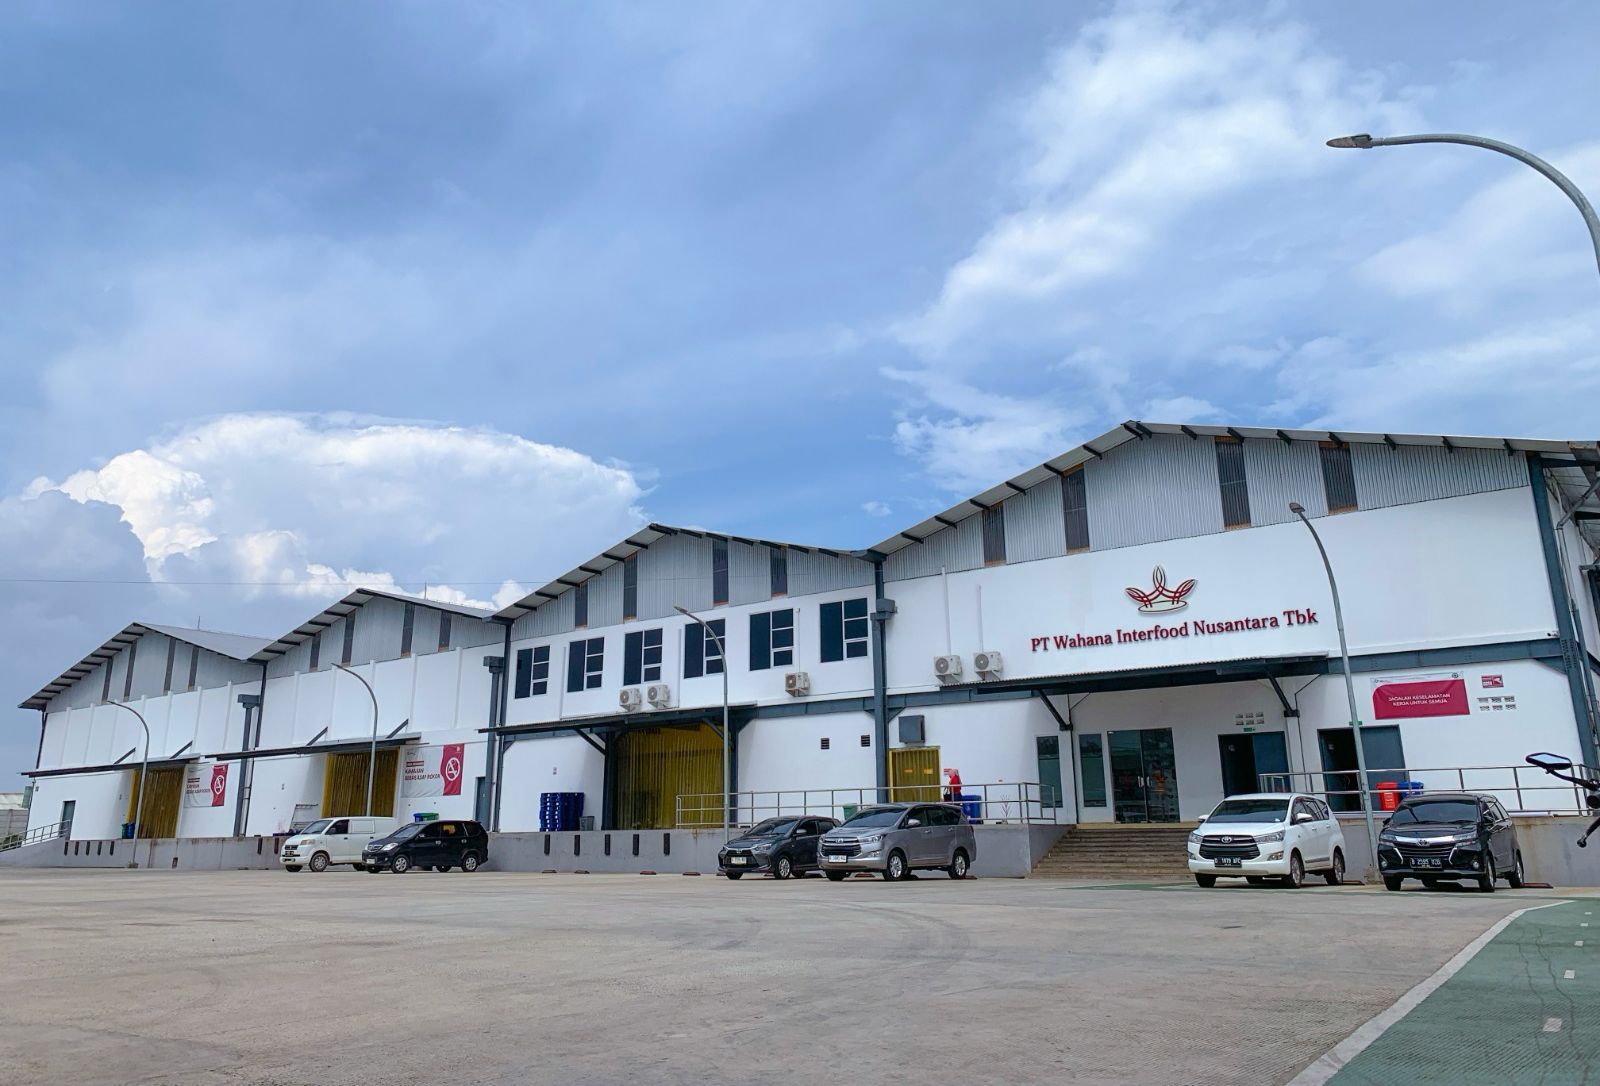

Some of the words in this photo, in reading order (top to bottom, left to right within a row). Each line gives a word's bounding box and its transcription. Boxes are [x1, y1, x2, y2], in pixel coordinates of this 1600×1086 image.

[1031, 637, 1049, 651] PT
[1053, 633, 1112, 649] Wahana
[1116, 622, 1188, 643] Interfood
[1193, 617, 1279, 635] Nusantara
[1283, 608, 1318, 625] Tbk
